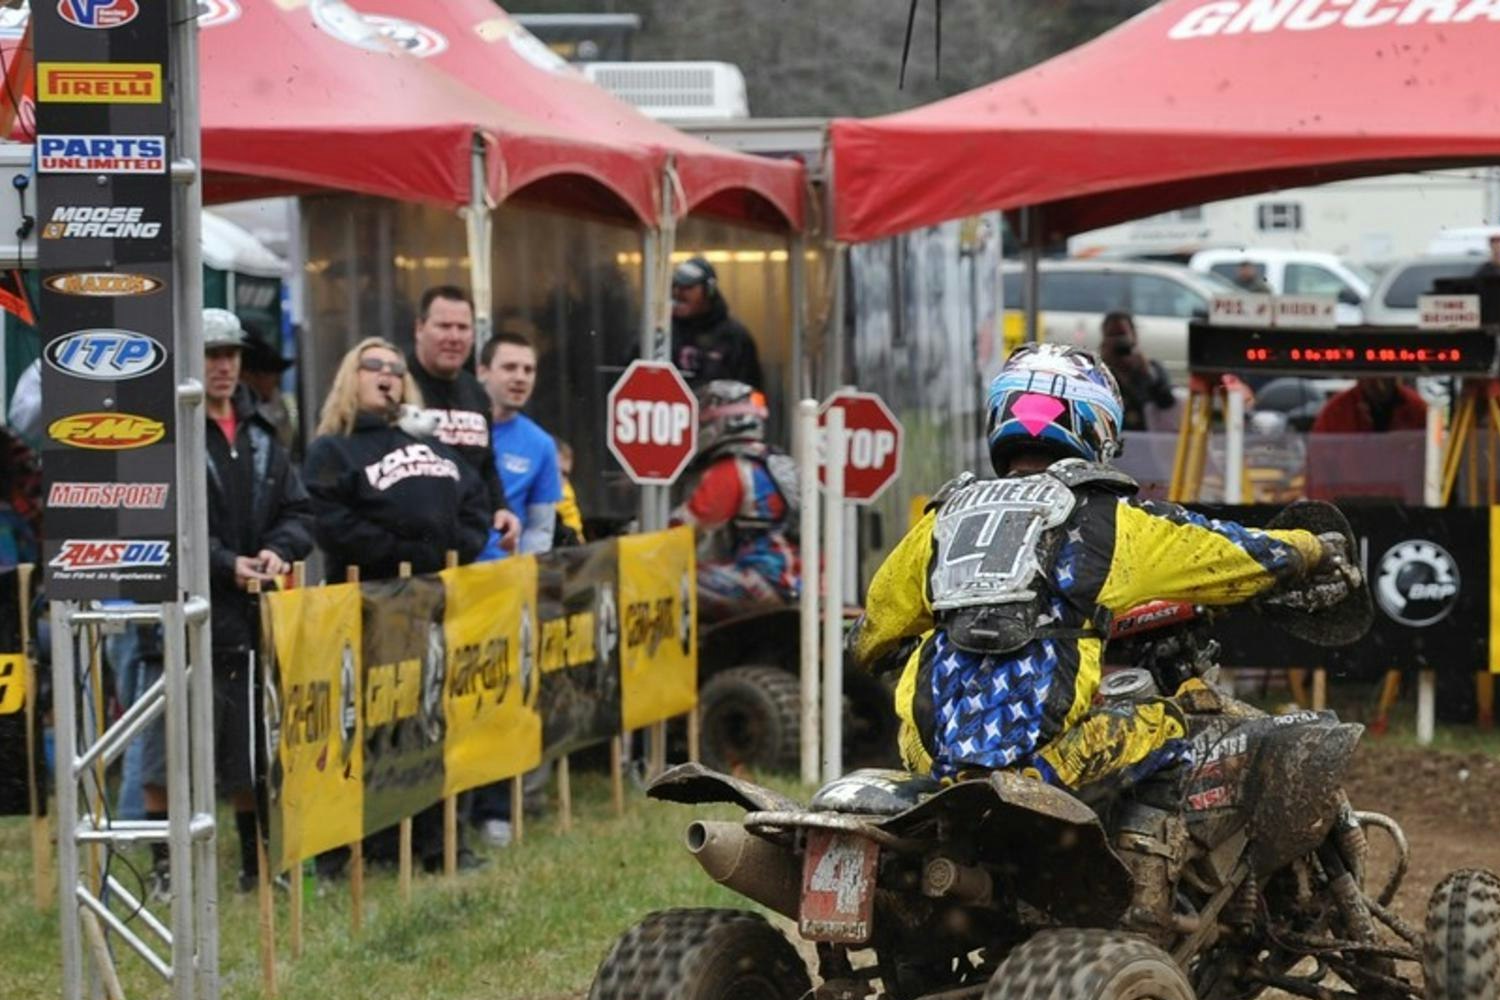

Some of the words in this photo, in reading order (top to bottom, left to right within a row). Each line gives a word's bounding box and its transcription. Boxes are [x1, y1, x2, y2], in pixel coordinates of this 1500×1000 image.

[48, 70, 155, 97] PIRELLI
[40, 138, 162, 158] PARTS
[42, 158, 162, 170] UNLIMITED
[52, 206, 144, 223] MOOSE
[63, 223, 161, 239] RACING
[58, 336, 150, 371] ITP
[50, 418, 165, 441] FMF
[615, 400, 691, 445] STOP
[52, 541, 169, 570] AMSOIL
[944, 508, 1041, 578] 4
[810, 836, 866, 914] 4
